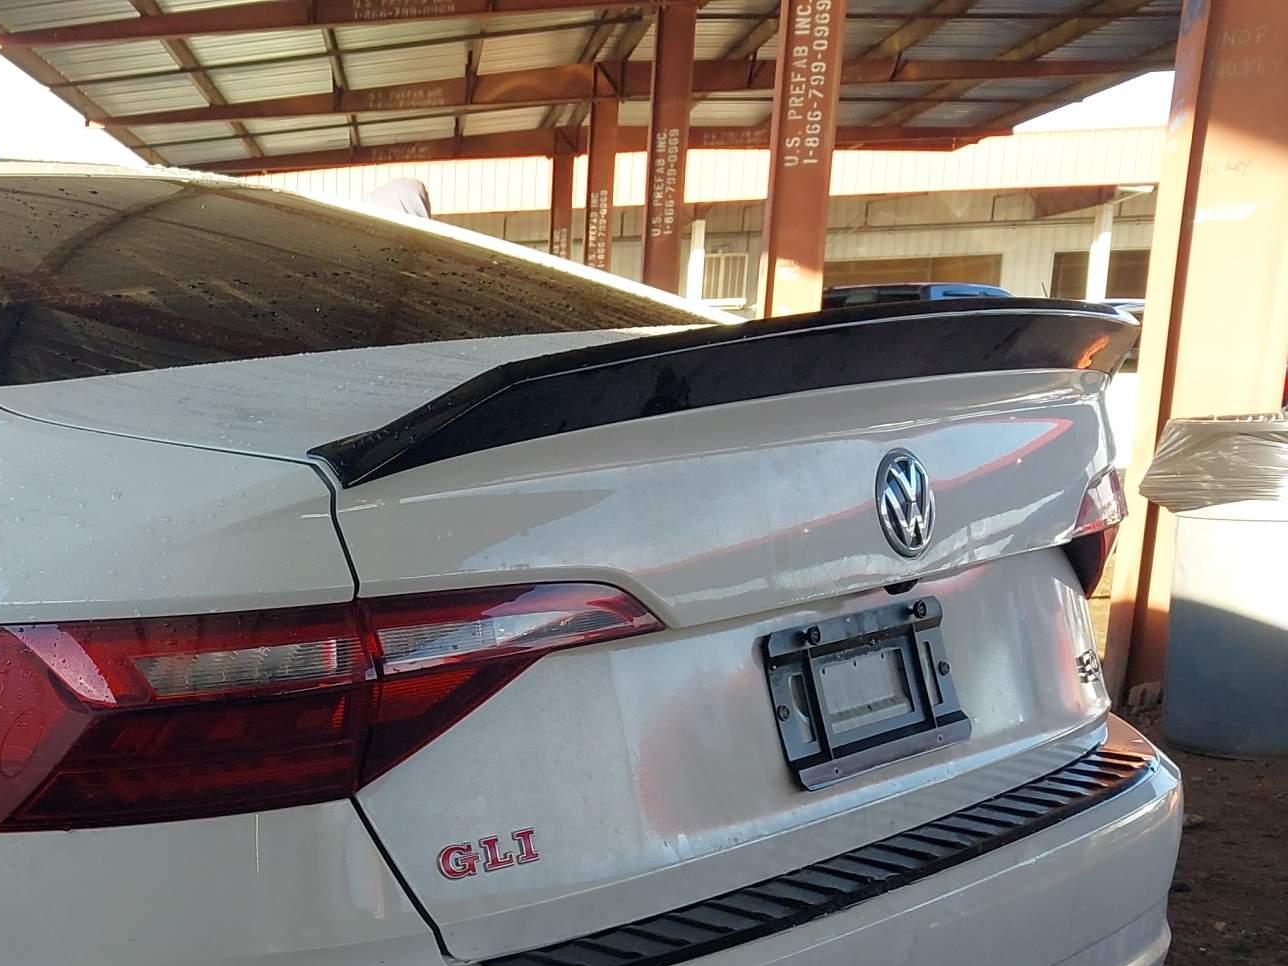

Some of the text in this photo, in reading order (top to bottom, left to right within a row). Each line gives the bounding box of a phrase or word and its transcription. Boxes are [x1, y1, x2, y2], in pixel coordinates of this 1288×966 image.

[788, 45, 809, 120] PREFAB
[803, 0, 832, 164] 1-866-799-0969
[784, 130, 802, 167] U.S.
[653, 158, 665, 207] PREFAB
[663, 128, 679, 235] 1-866-799-0969
[651, 212, 663, 237] U.S.
[437, 827, 541, 880] GLI
